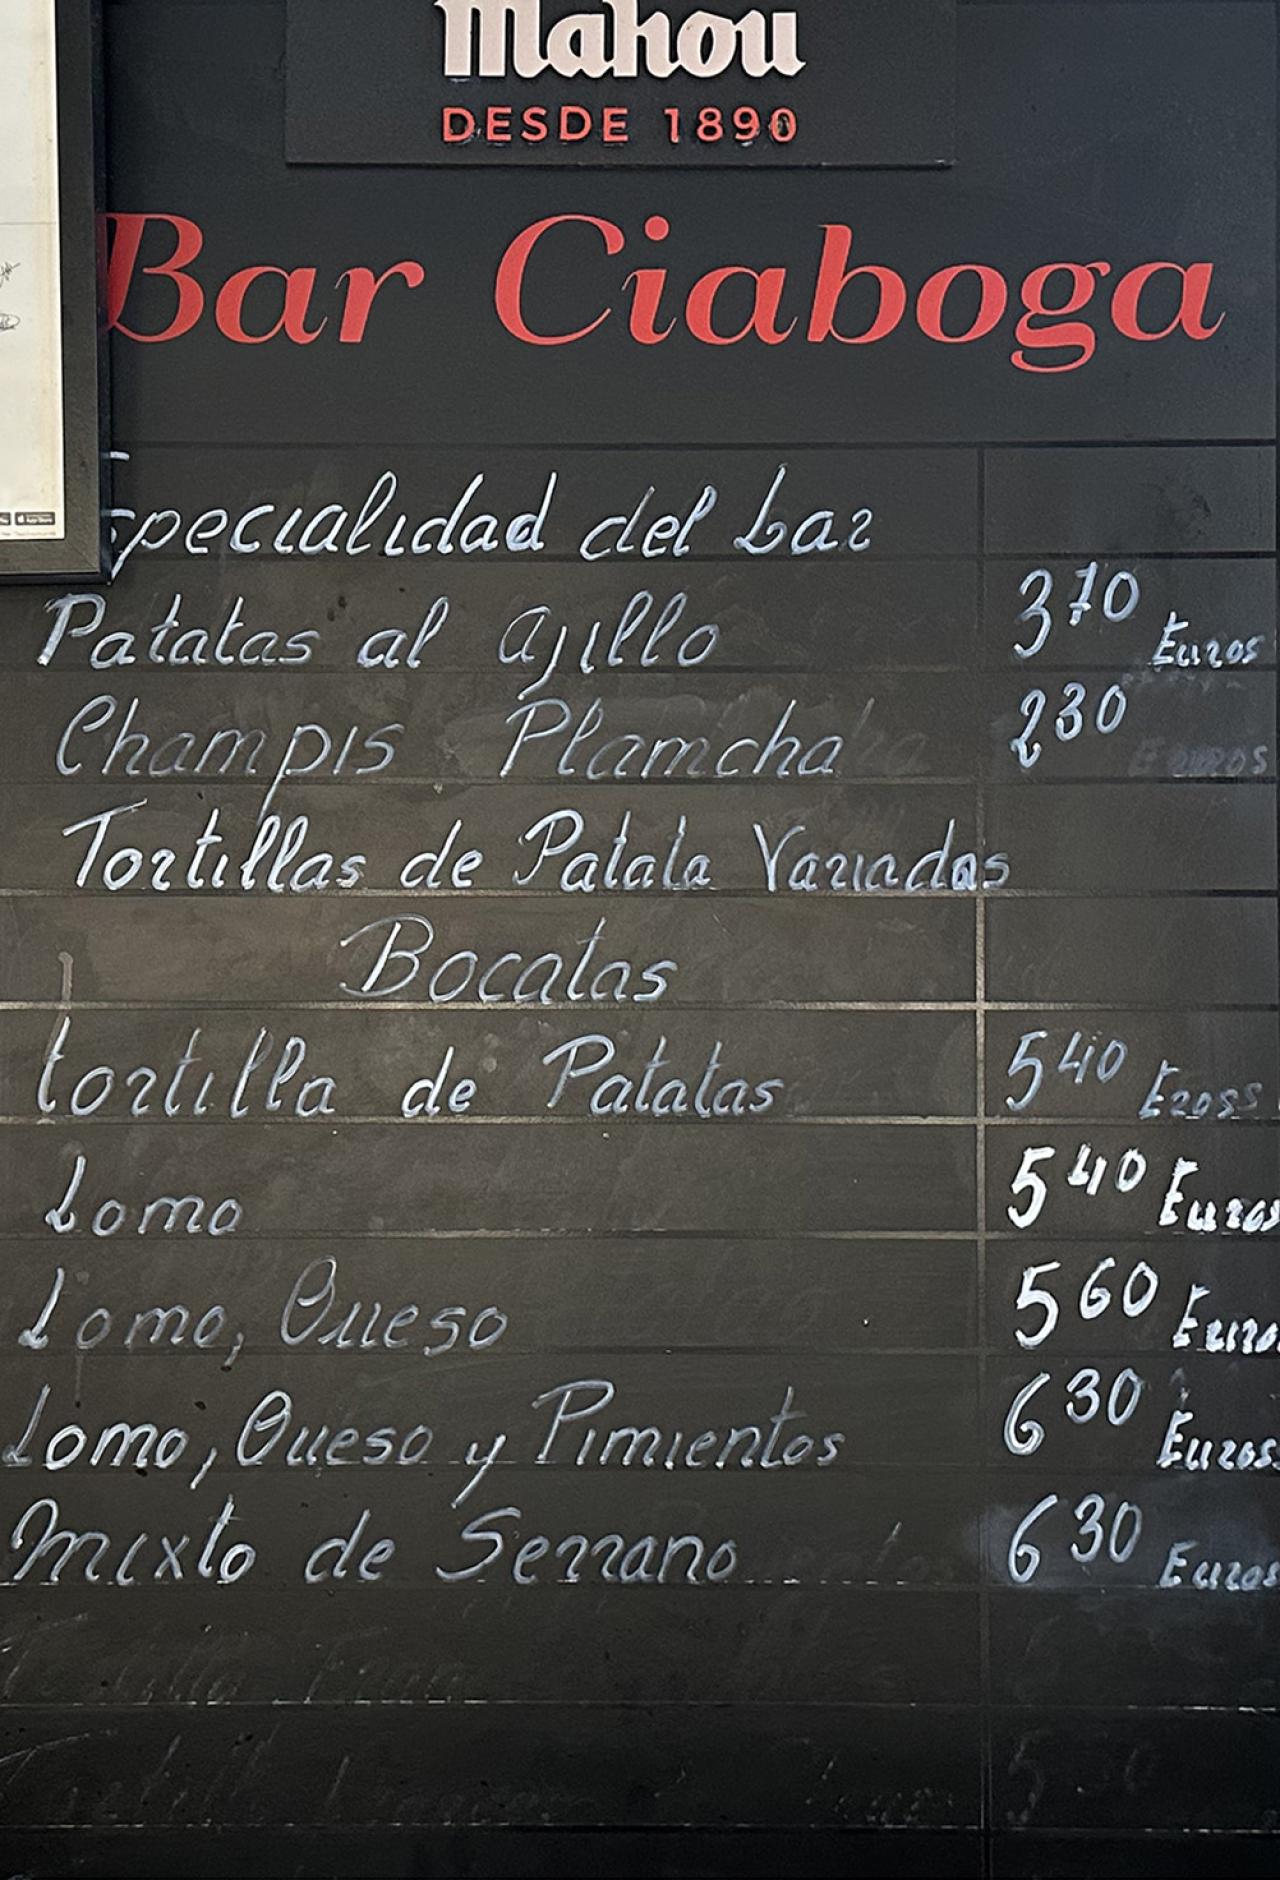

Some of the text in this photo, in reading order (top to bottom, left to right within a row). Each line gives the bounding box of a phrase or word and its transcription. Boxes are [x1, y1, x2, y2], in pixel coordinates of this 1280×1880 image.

[436, 0, 806, 80] Mahou
[442, 106, 799, 144] DESDE 1890
[106, 213, 1226, 374] Bar Ciaboga
[579, 485, 718, 561] del
[37, 592, 320, 668] Patatas
[356, 596, 449, 669] al
[1150, 610, 1262, 668] Euros
[55, 694, 405, 822] Champis
[62, 798, 1011, 893] Tortillas de Patata Variadas
[337, 913, 678, 1005] Bocatas
[401, 1045, 478, 1119] de
[542, 1033, 784, 1119] Patatas
[45, 1155, 243, 1236] Lomo
[236, 1390, 434, 1467] Queso
[451, 1433, 507, 1508] y
[531, 1380, 845, 1470] Pimientos
[304, 1508, 397, 1584] de
[436, 1506, 738, 1584] Serrano
